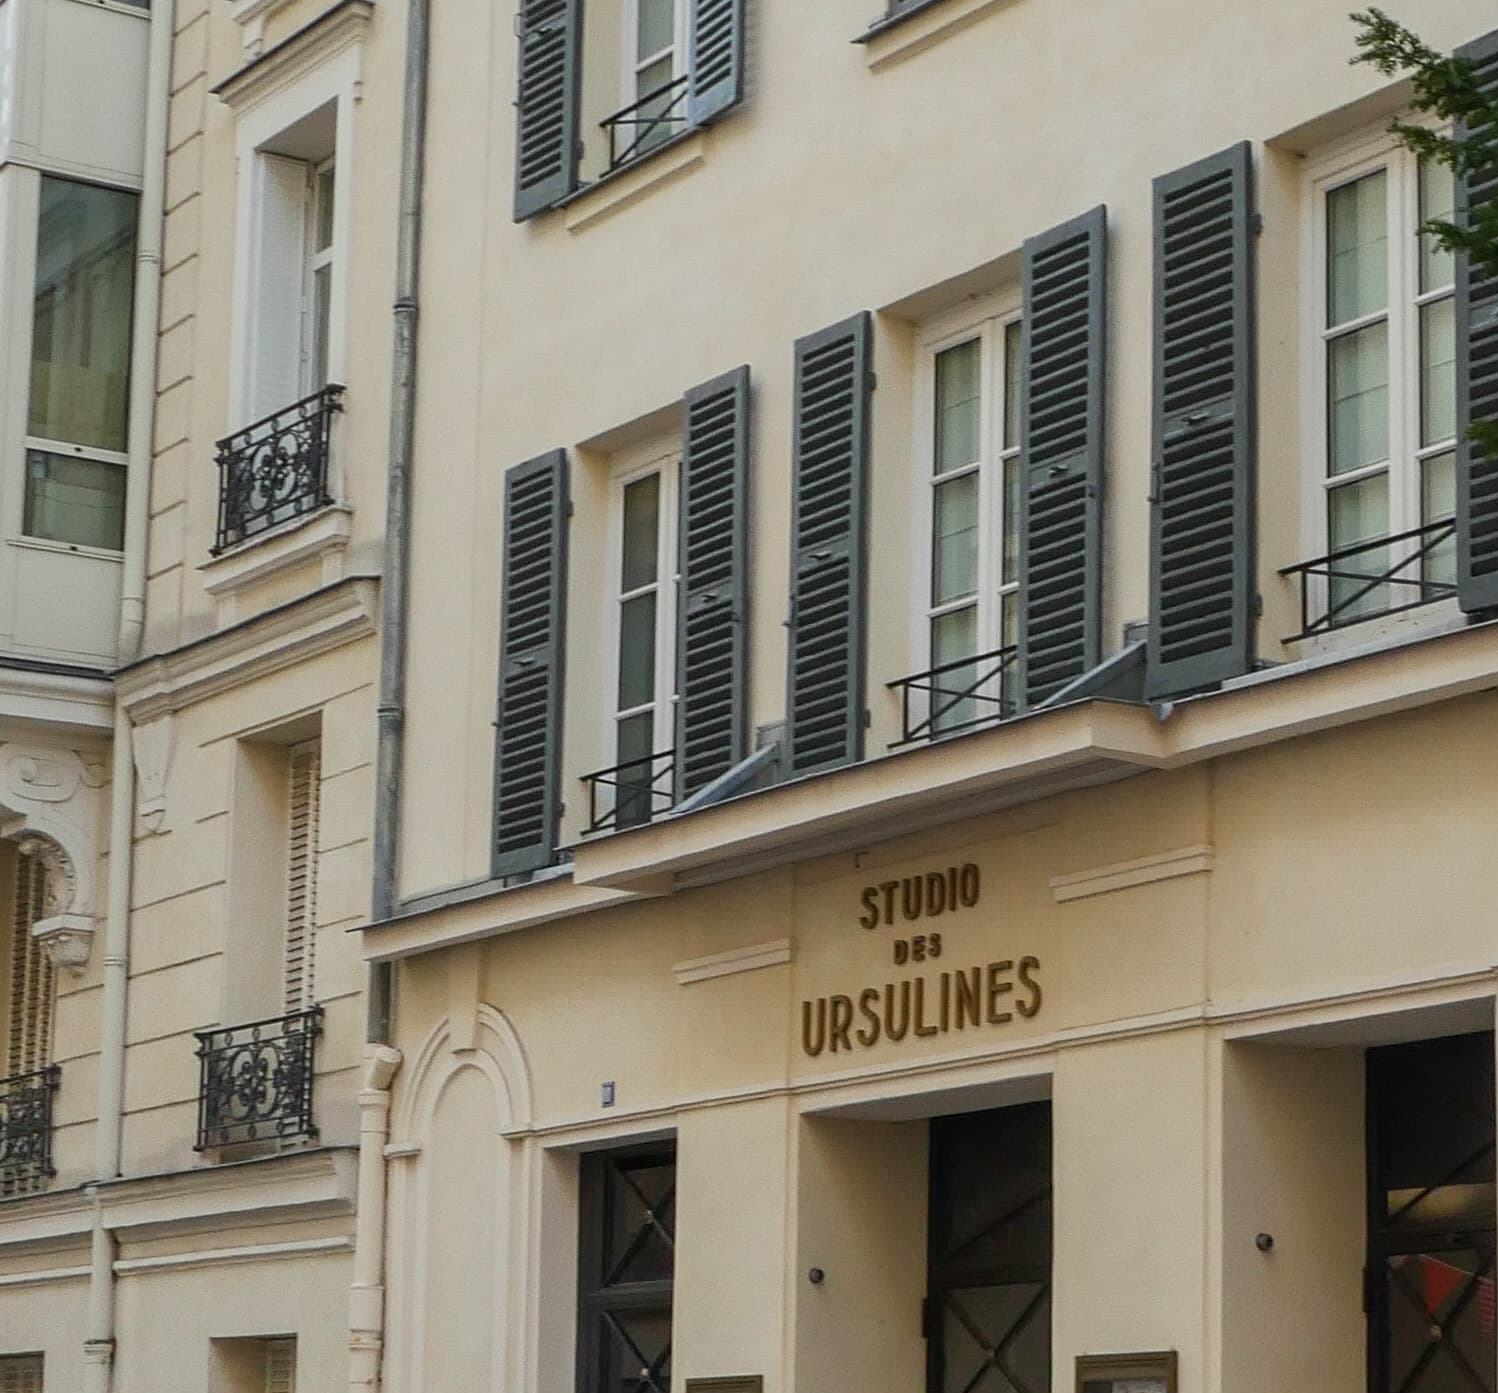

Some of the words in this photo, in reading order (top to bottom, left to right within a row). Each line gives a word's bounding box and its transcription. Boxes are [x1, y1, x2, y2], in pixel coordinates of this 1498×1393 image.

[859, 863, 980, 930] STUDIO
[893, 933, 942, 965] DES
[802, 955, 1042, 1057] URSULINES
